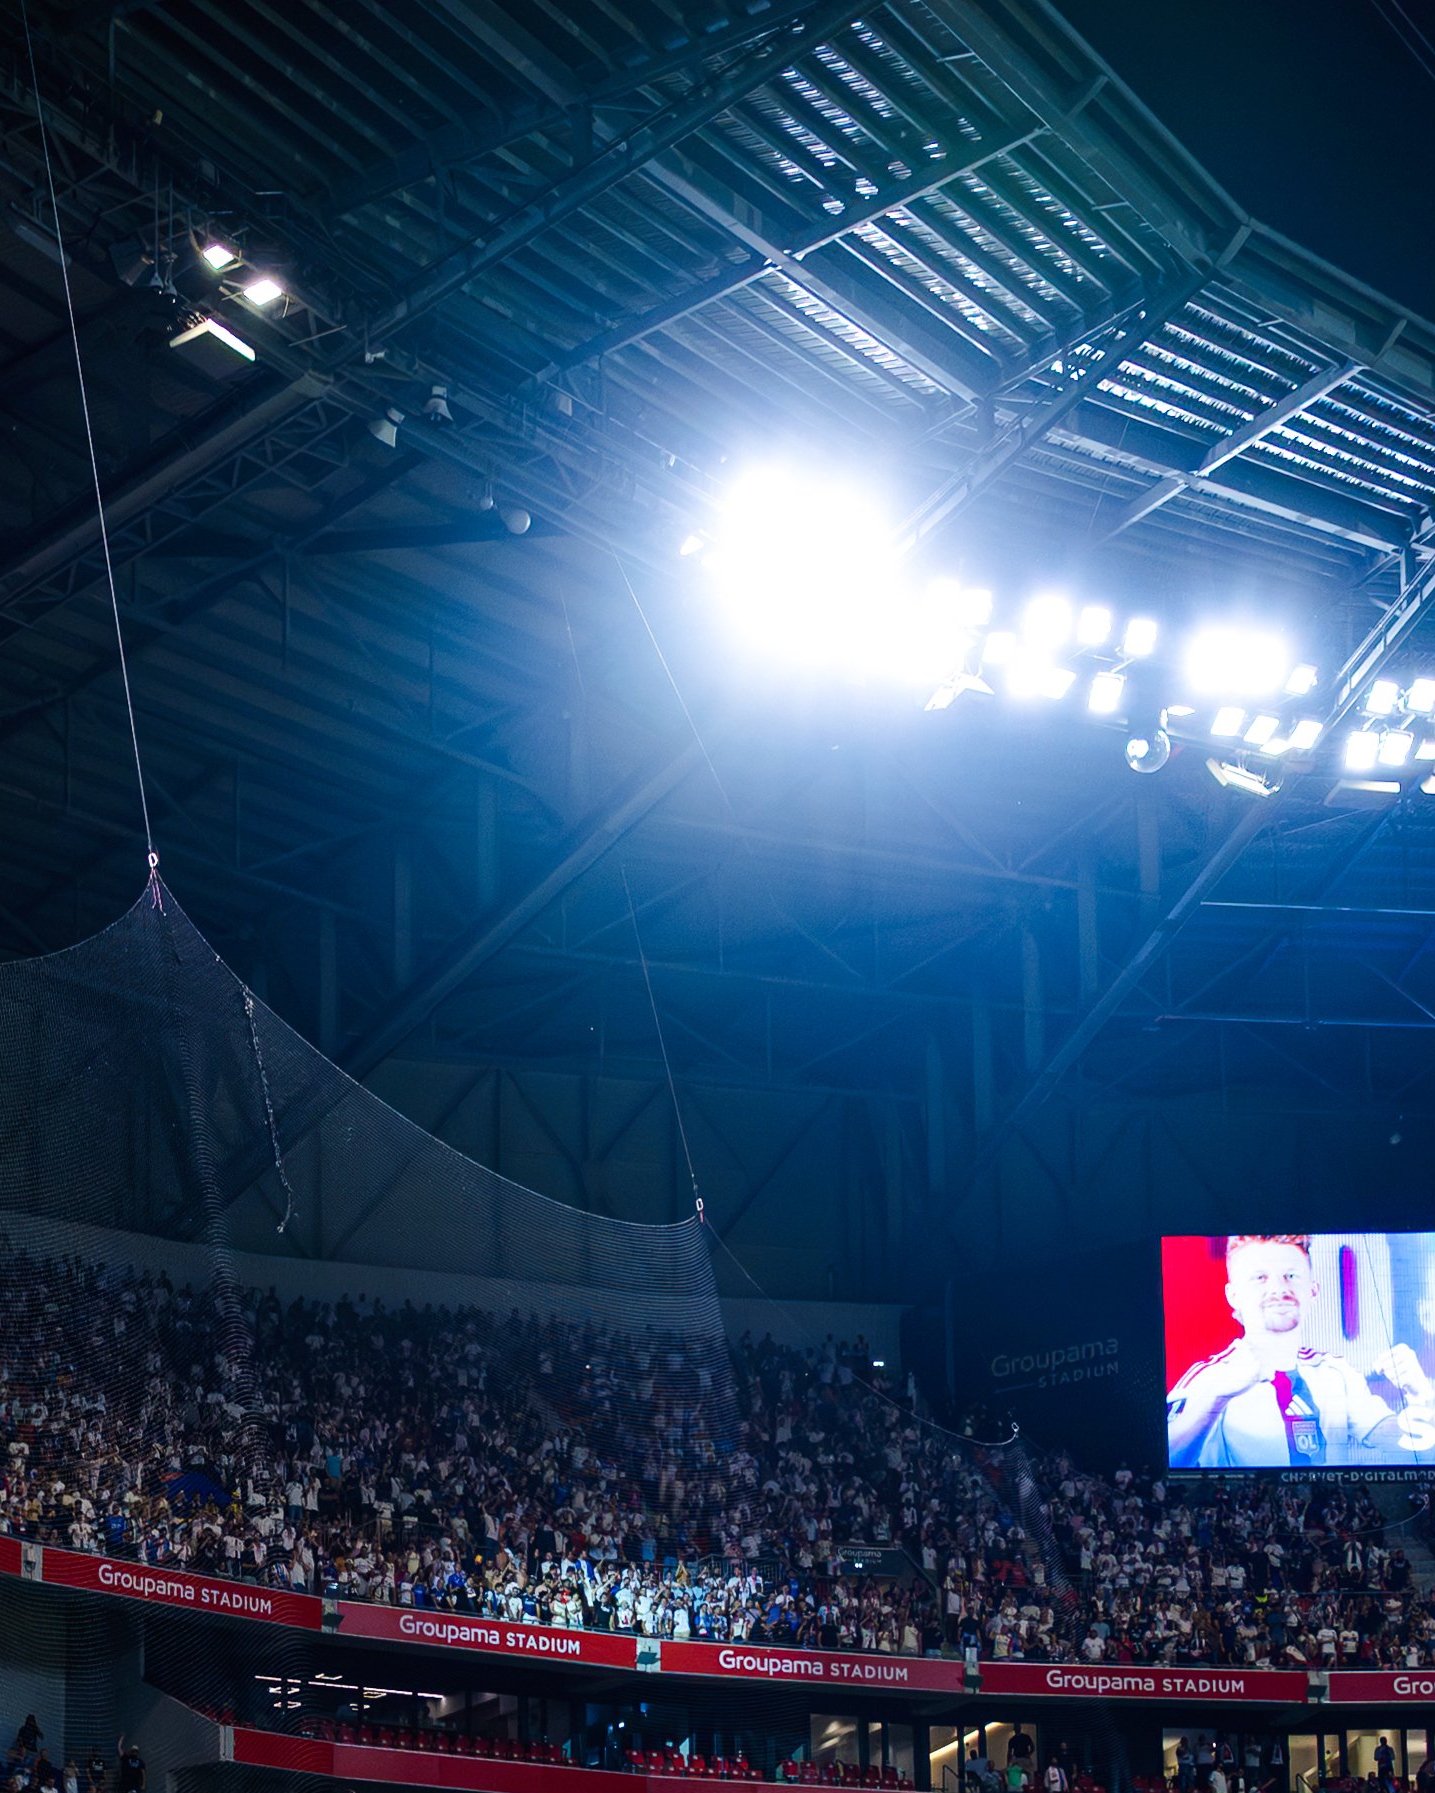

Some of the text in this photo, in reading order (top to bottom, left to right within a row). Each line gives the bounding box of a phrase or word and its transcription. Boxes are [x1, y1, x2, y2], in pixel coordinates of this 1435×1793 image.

[991, 1338, 1119, 1377] Groupama
[1038, 1361, 1119, 1389] STADIUM
[97, 1562, 273, 1616] Groupama STADIUM
[399, 1613, 582, 1656] Groupama STADIUM
[717, 1649, 910, 1682] Groupama STADIUM
[1045, 1668, 1246, 1699] Groupama STADIUM
